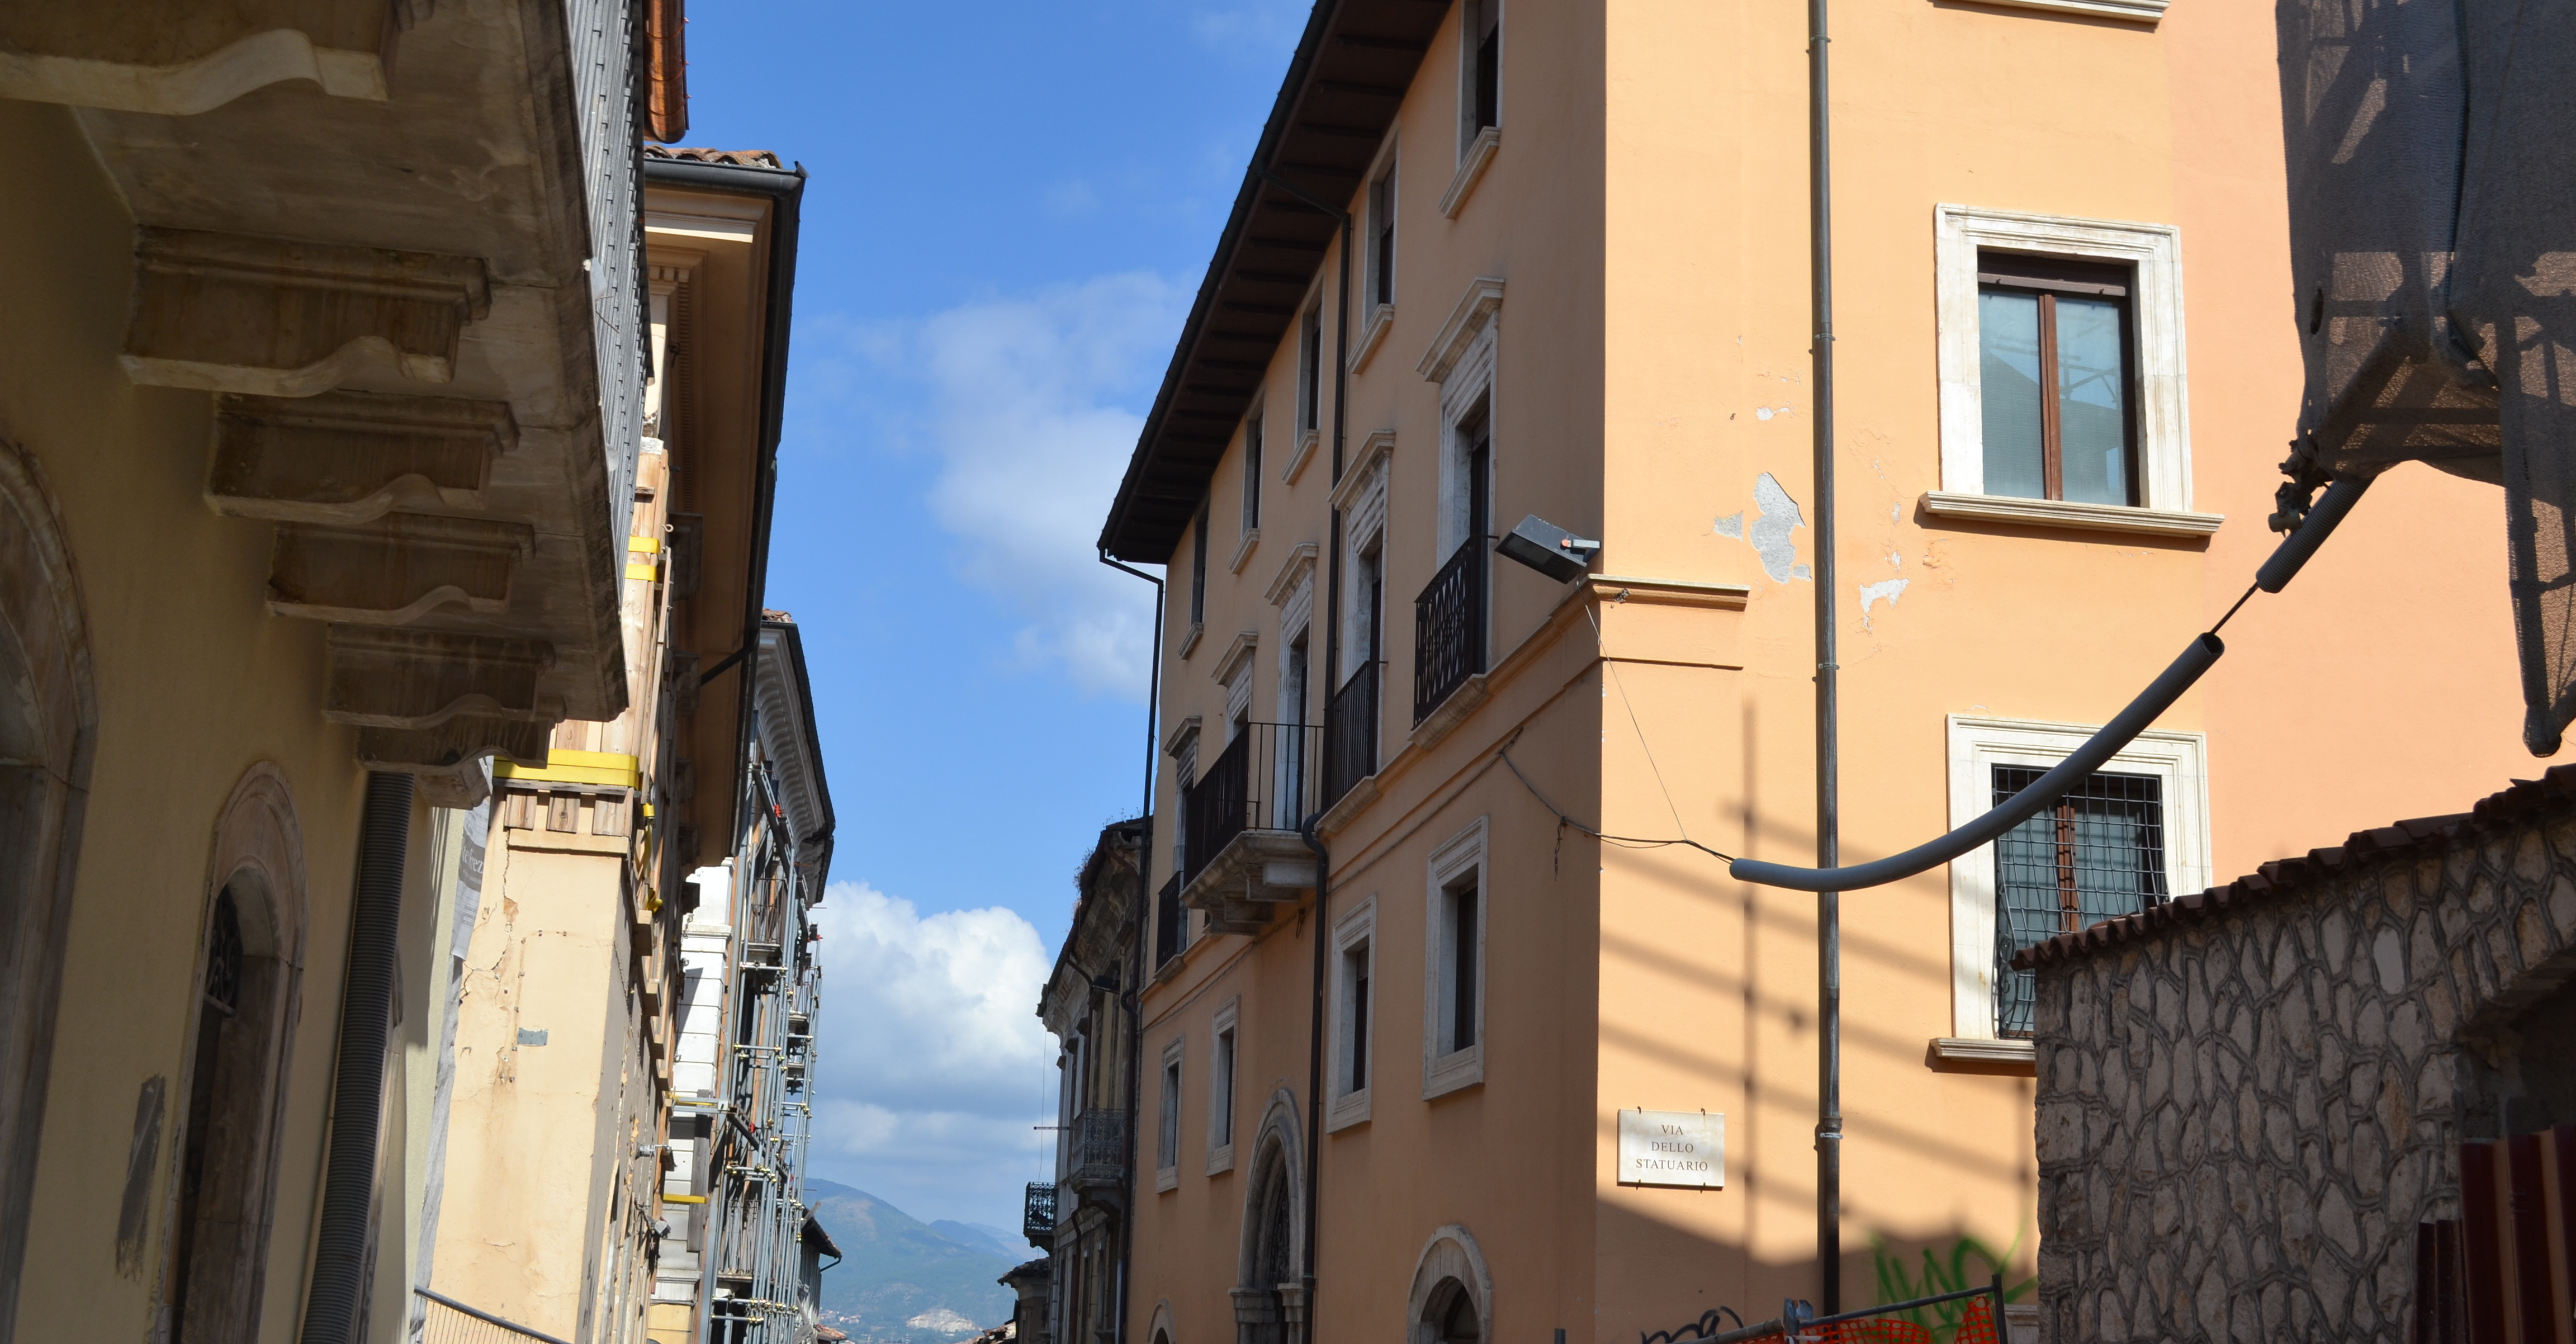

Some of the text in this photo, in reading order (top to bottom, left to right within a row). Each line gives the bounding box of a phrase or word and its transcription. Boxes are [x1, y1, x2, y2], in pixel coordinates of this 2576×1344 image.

[1661, 1124, 1684, 1135] VIA
[1651, 1141, 1694, 1153] DELLO
[1636, 1158, 1708, 1171] STATUARIO
